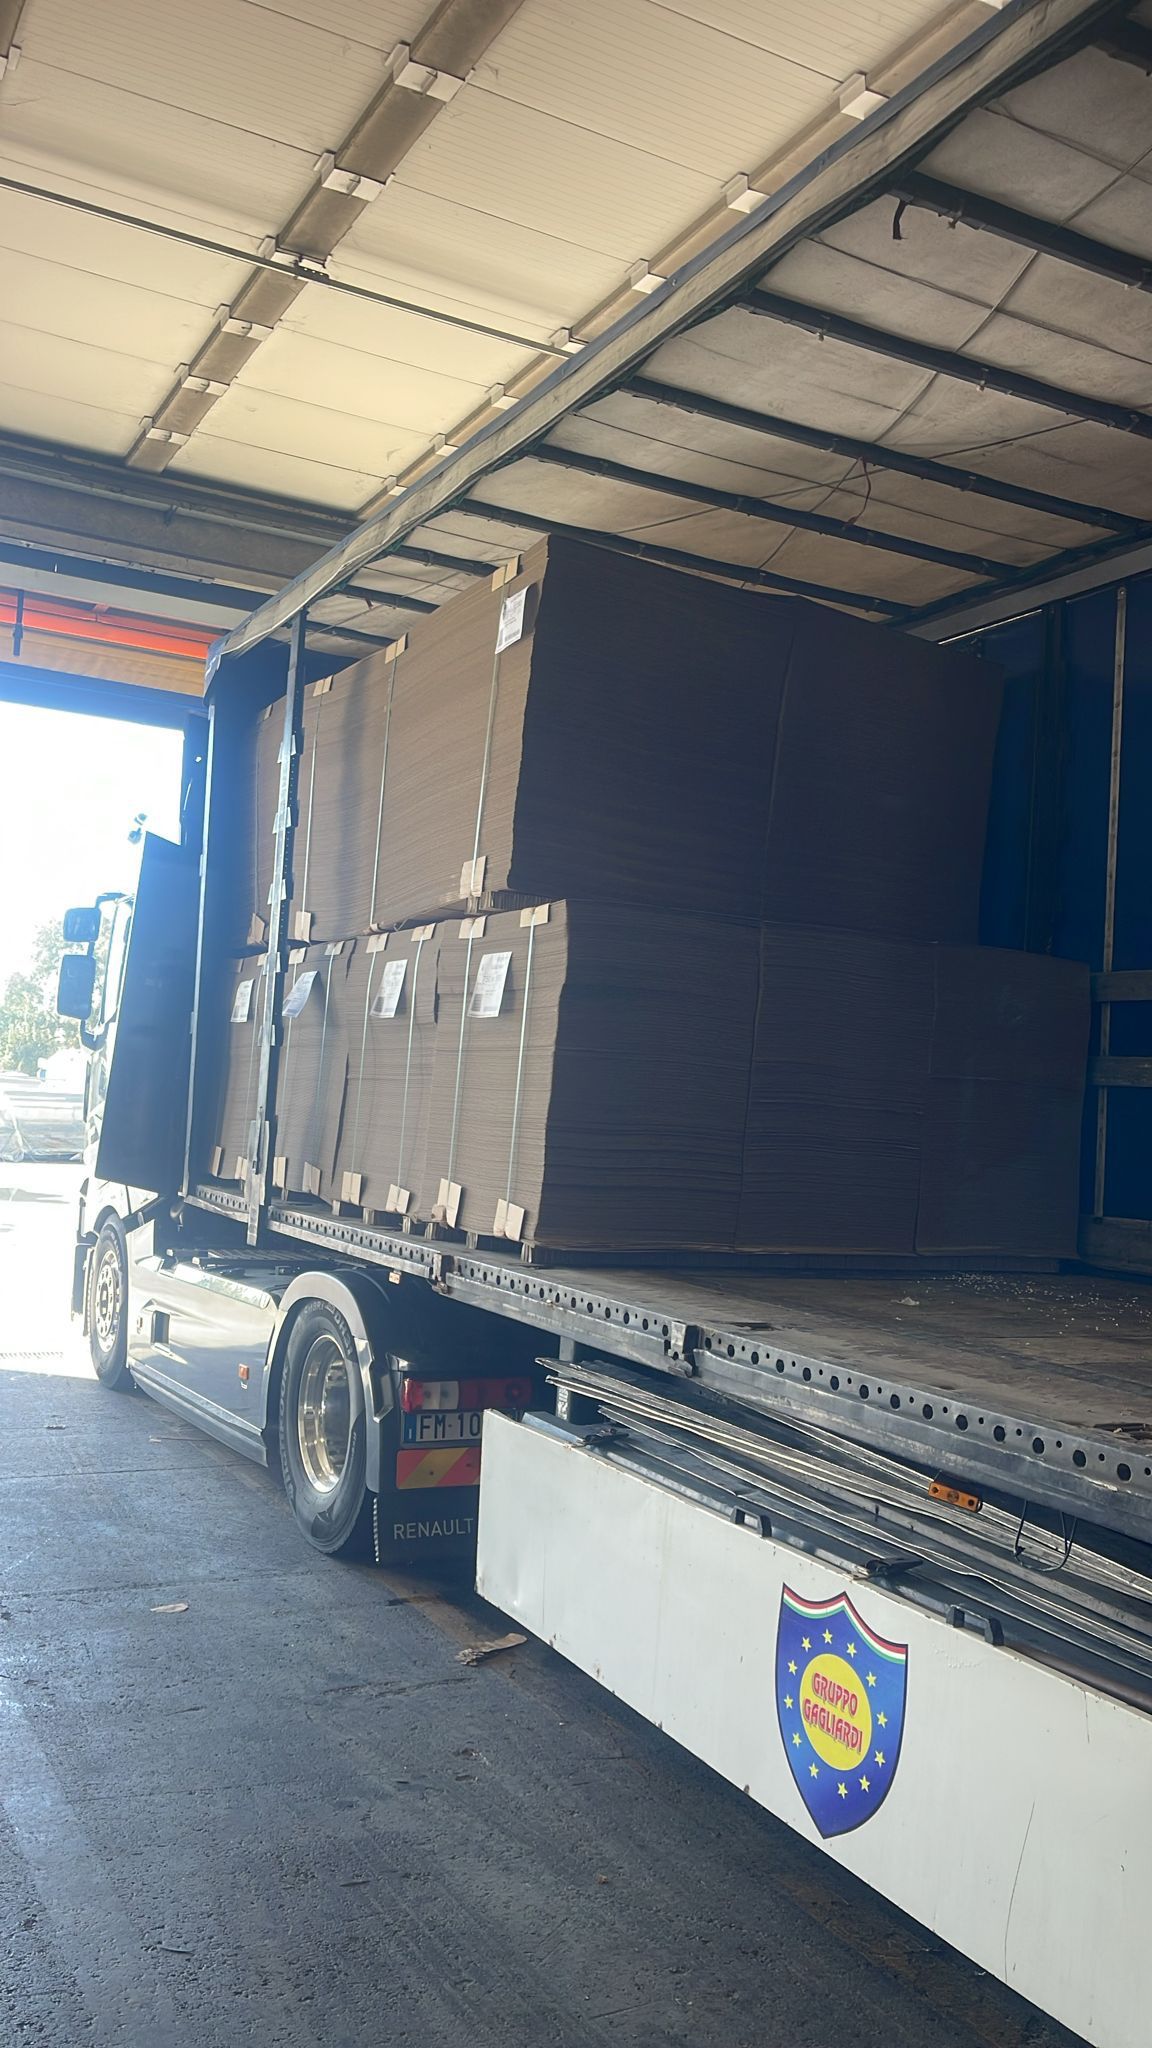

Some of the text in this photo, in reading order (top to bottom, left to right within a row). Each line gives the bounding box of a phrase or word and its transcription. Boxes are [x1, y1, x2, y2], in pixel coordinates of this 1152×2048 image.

[419, 1414, 446, 1440] FM
[393, 1518, 474, 1540] RENAULT
[812, 1672, 859, 1718] GRUPPO
[802, 1698, 864, 1754] GAGLIARDI
